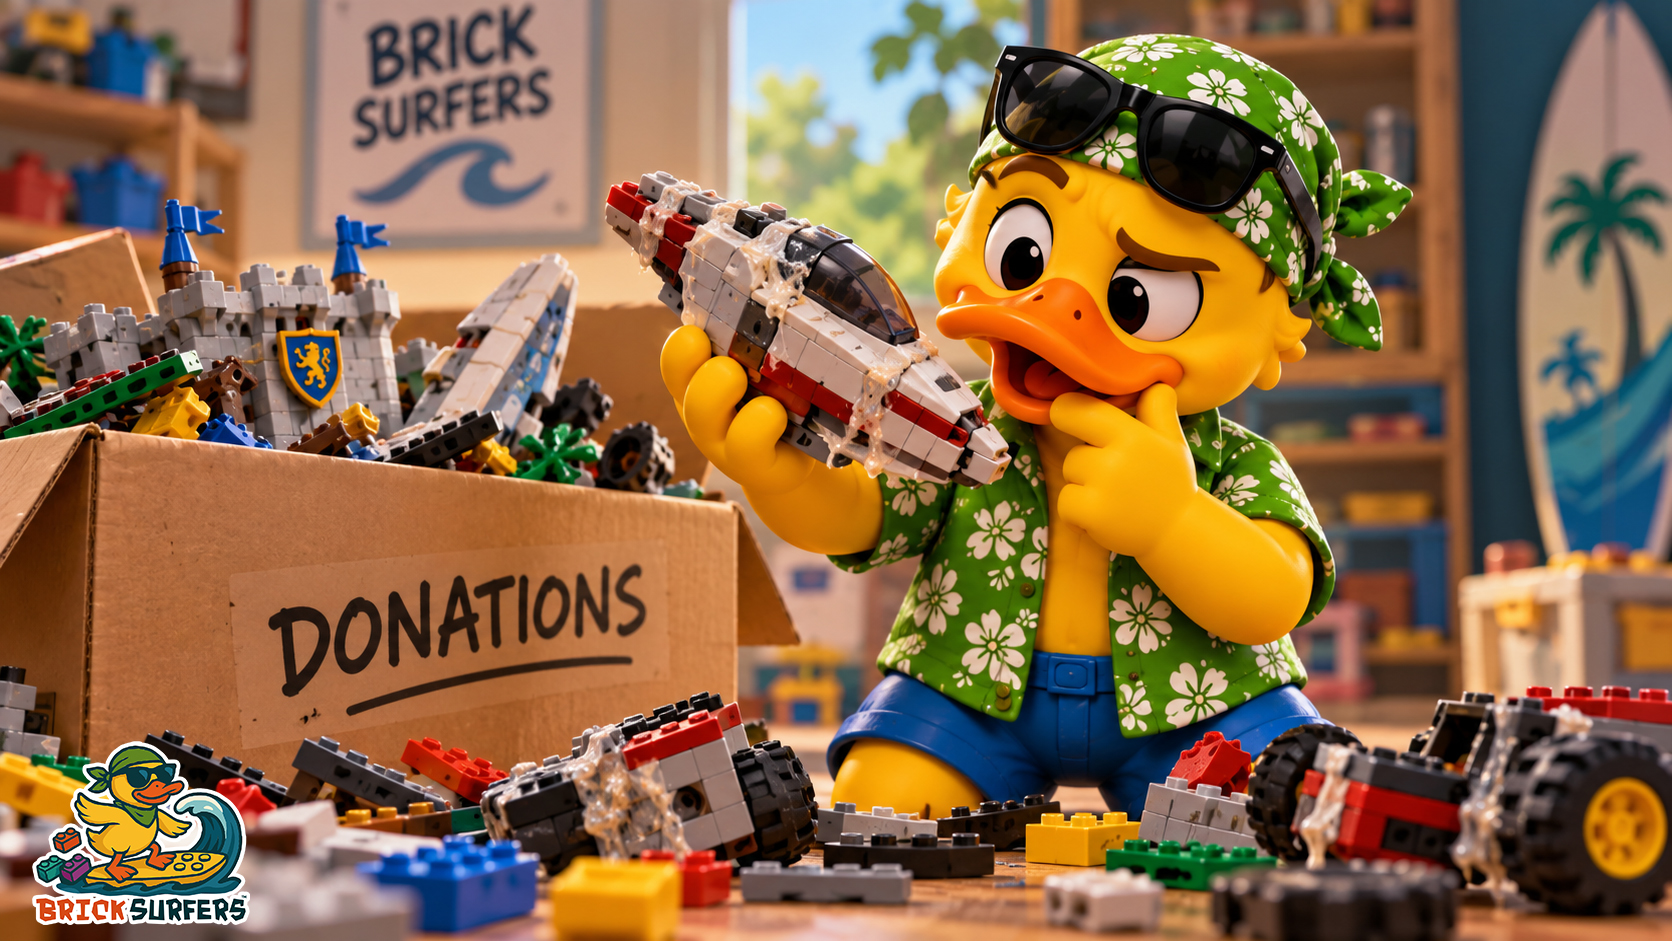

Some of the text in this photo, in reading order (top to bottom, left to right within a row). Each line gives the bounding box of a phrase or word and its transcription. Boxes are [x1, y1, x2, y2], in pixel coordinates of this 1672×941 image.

[367, 5, 537, 88] BRICK
[353, 69, 552, 149] SURFERS
[268, 564, 647, 697] DONATIONS
